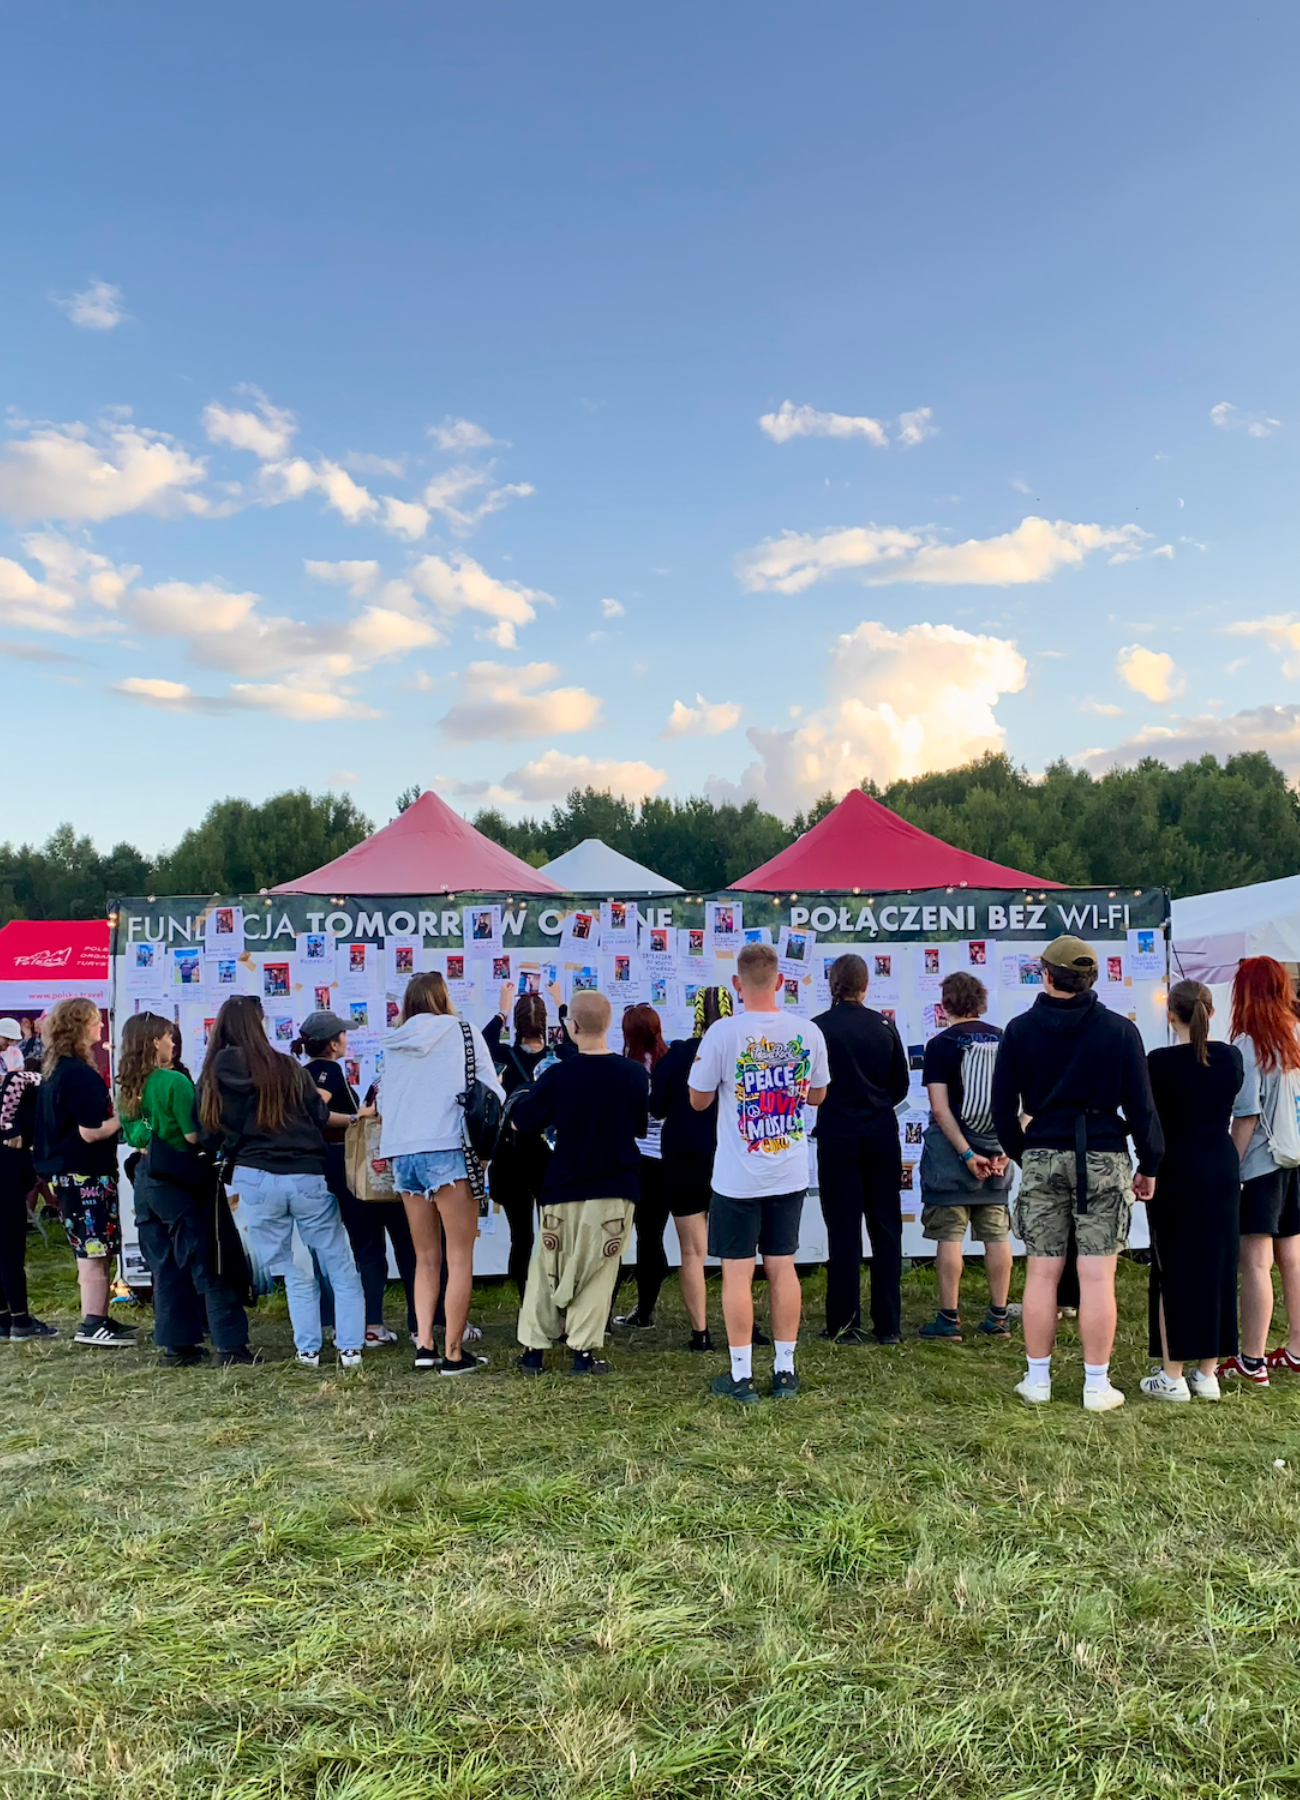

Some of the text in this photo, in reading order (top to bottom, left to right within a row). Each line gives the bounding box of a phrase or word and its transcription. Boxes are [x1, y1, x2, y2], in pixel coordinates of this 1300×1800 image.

[128, 913, 296, 942] FUNCJA
[306, 910, 527, 939] TOMORRW
[790, 903, 1130, 938] POŁĄCZENI BEZ WI-FI
[28, 991, 104, 1000] www.polsktravel
[744, 1066, 795, 1093] PEACE
[747, 1115, 796, 1141] MUSIC
